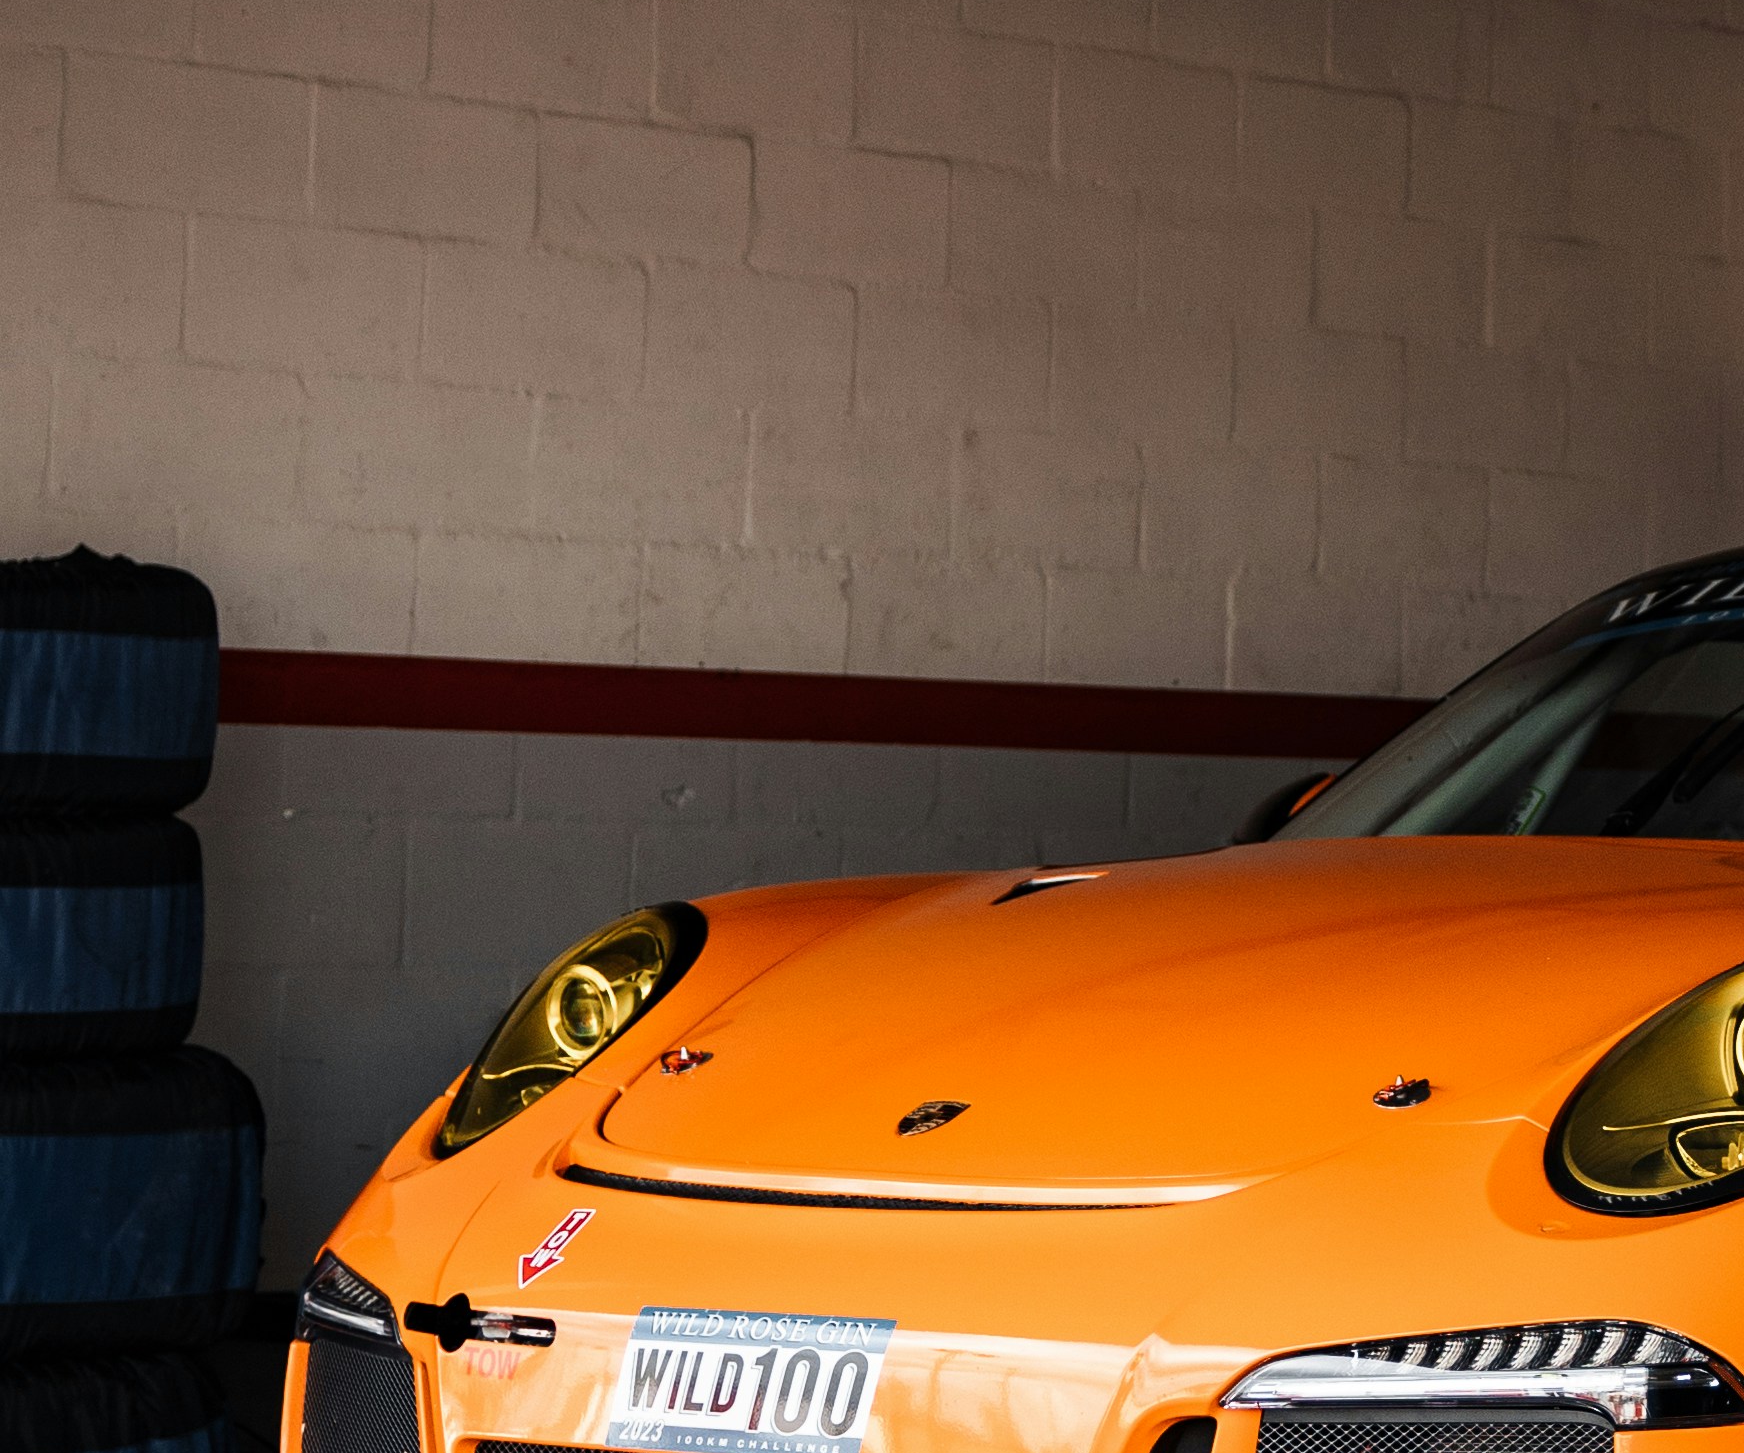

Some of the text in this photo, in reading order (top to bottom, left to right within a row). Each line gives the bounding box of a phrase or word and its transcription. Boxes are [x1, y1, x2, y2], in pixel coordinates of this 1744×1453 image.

[529, 1212, 588, 1268] TOW
[651, 1310, 878, 1347] WILD ROSE GIN
[463, 1346, 521, 1380] TOW
[628, 1347, 870, 1437] WILD100
[619, 1419, 665, 1443] 2023
[676, 1434, 729, 1448] 100KM
